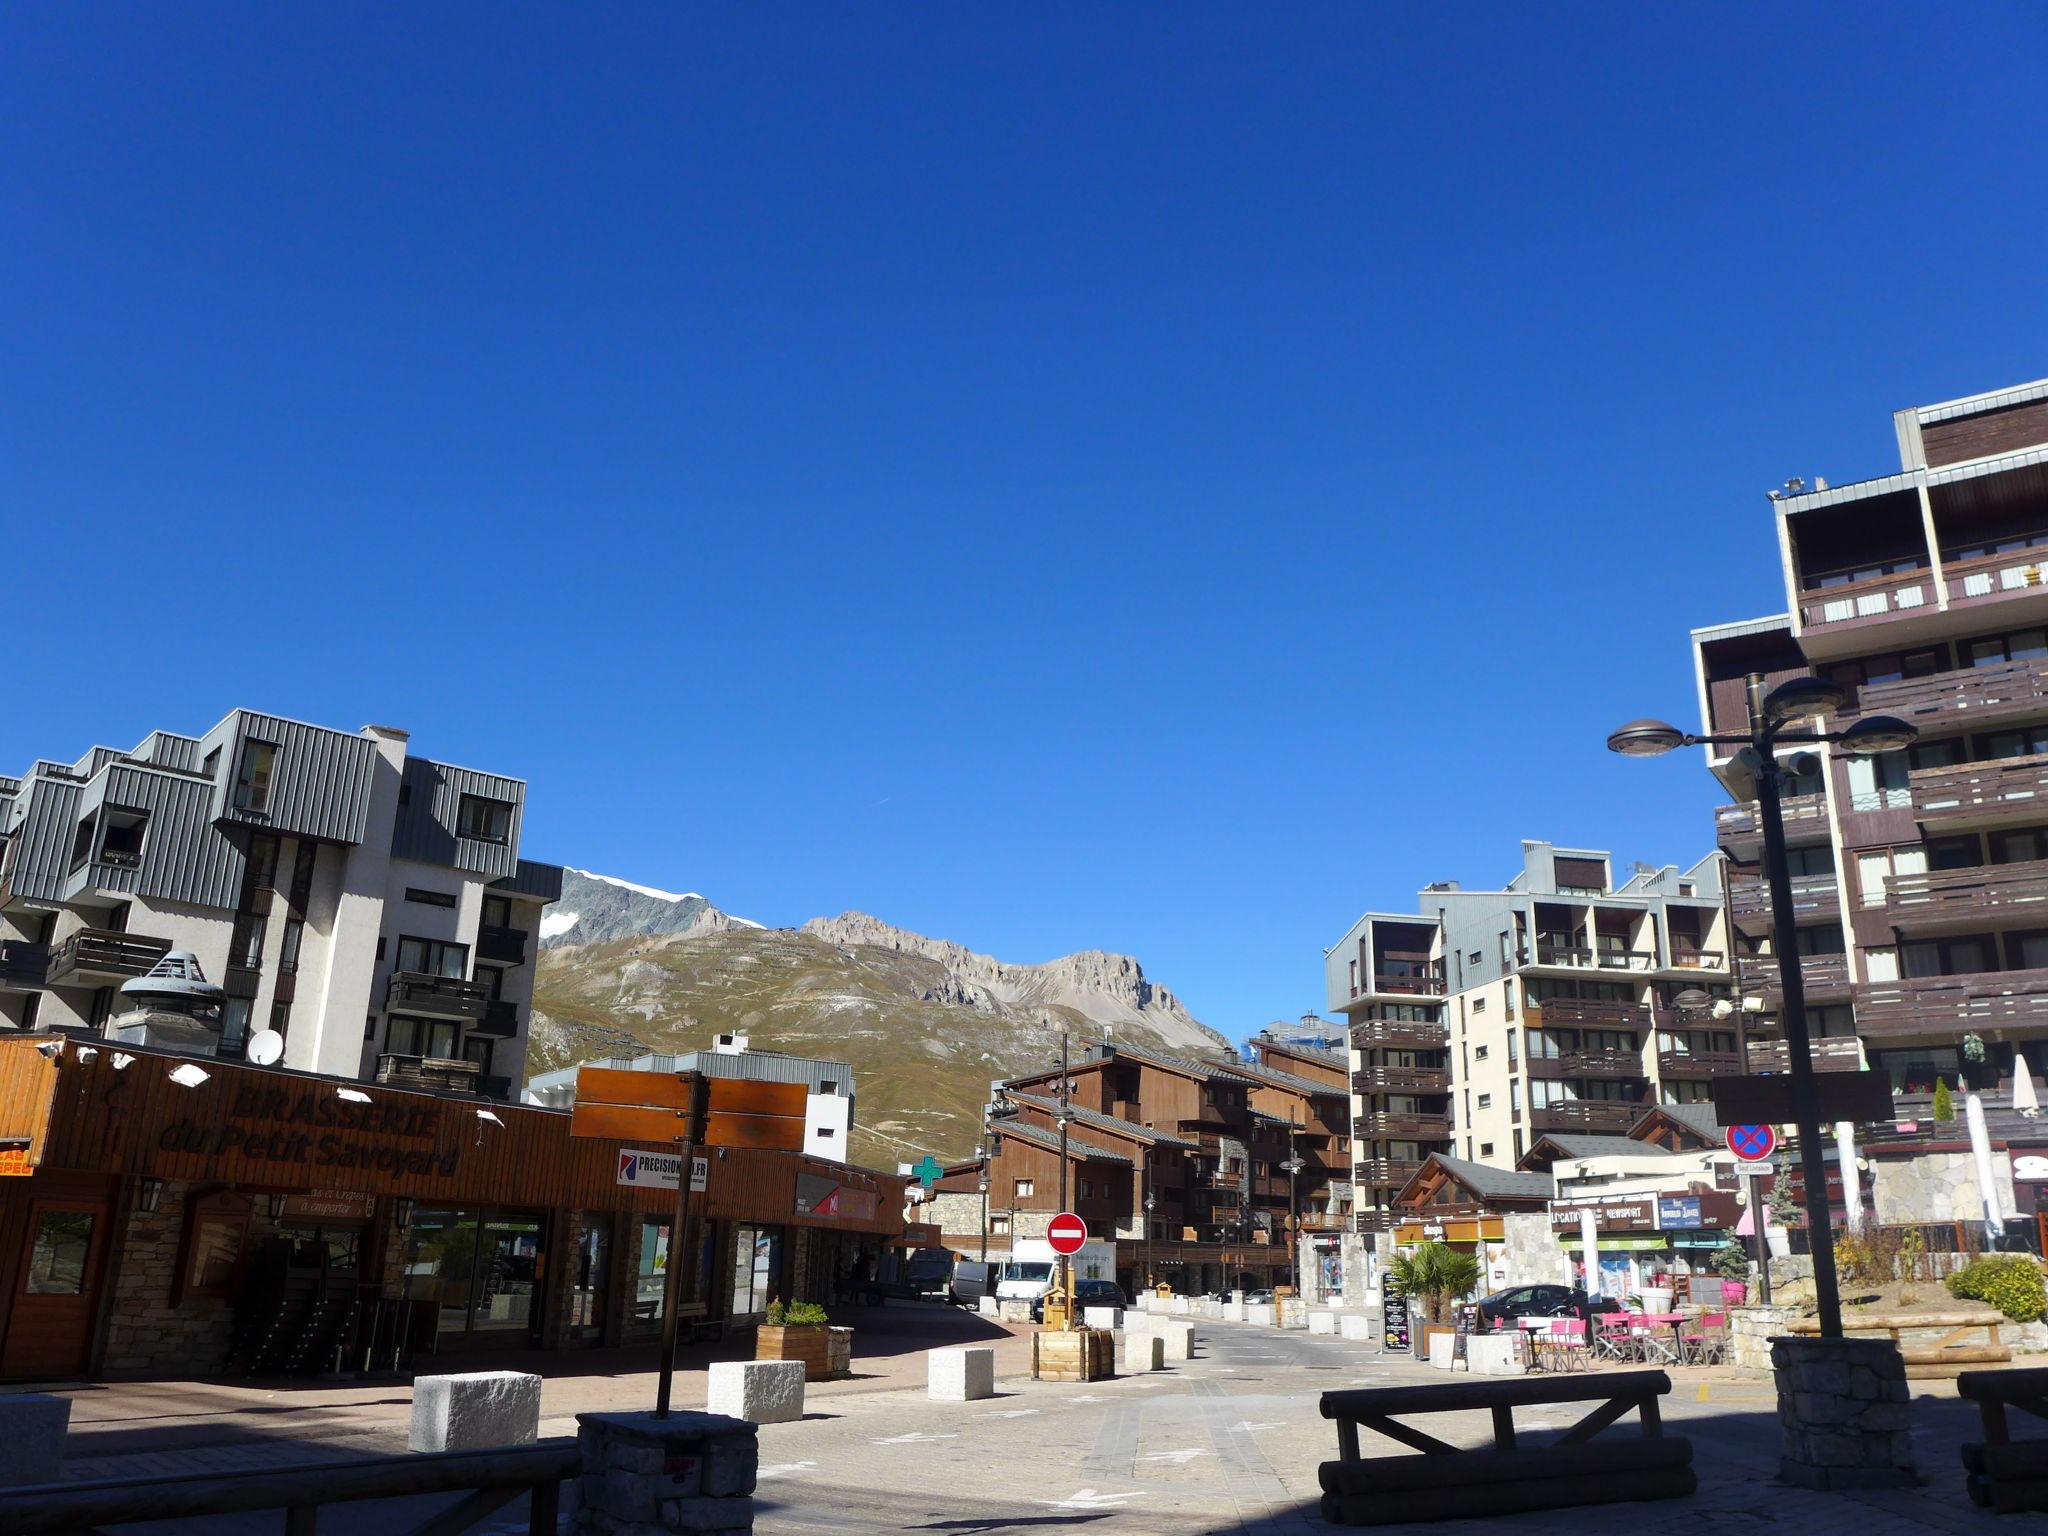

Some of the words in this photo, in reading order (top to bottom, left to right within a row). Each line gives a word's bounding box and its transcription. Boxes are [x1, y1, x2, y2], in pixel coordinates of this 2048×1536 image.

[232, 1084, 440, 1138] BRASSERIE
[158, 1119, 205, 1154] du
[212, 1124, 311, 1163] Petit
[315, 1133, 461, 1179] Savoyard
[1551, 1210, 1583, 1224] LOCATIO
